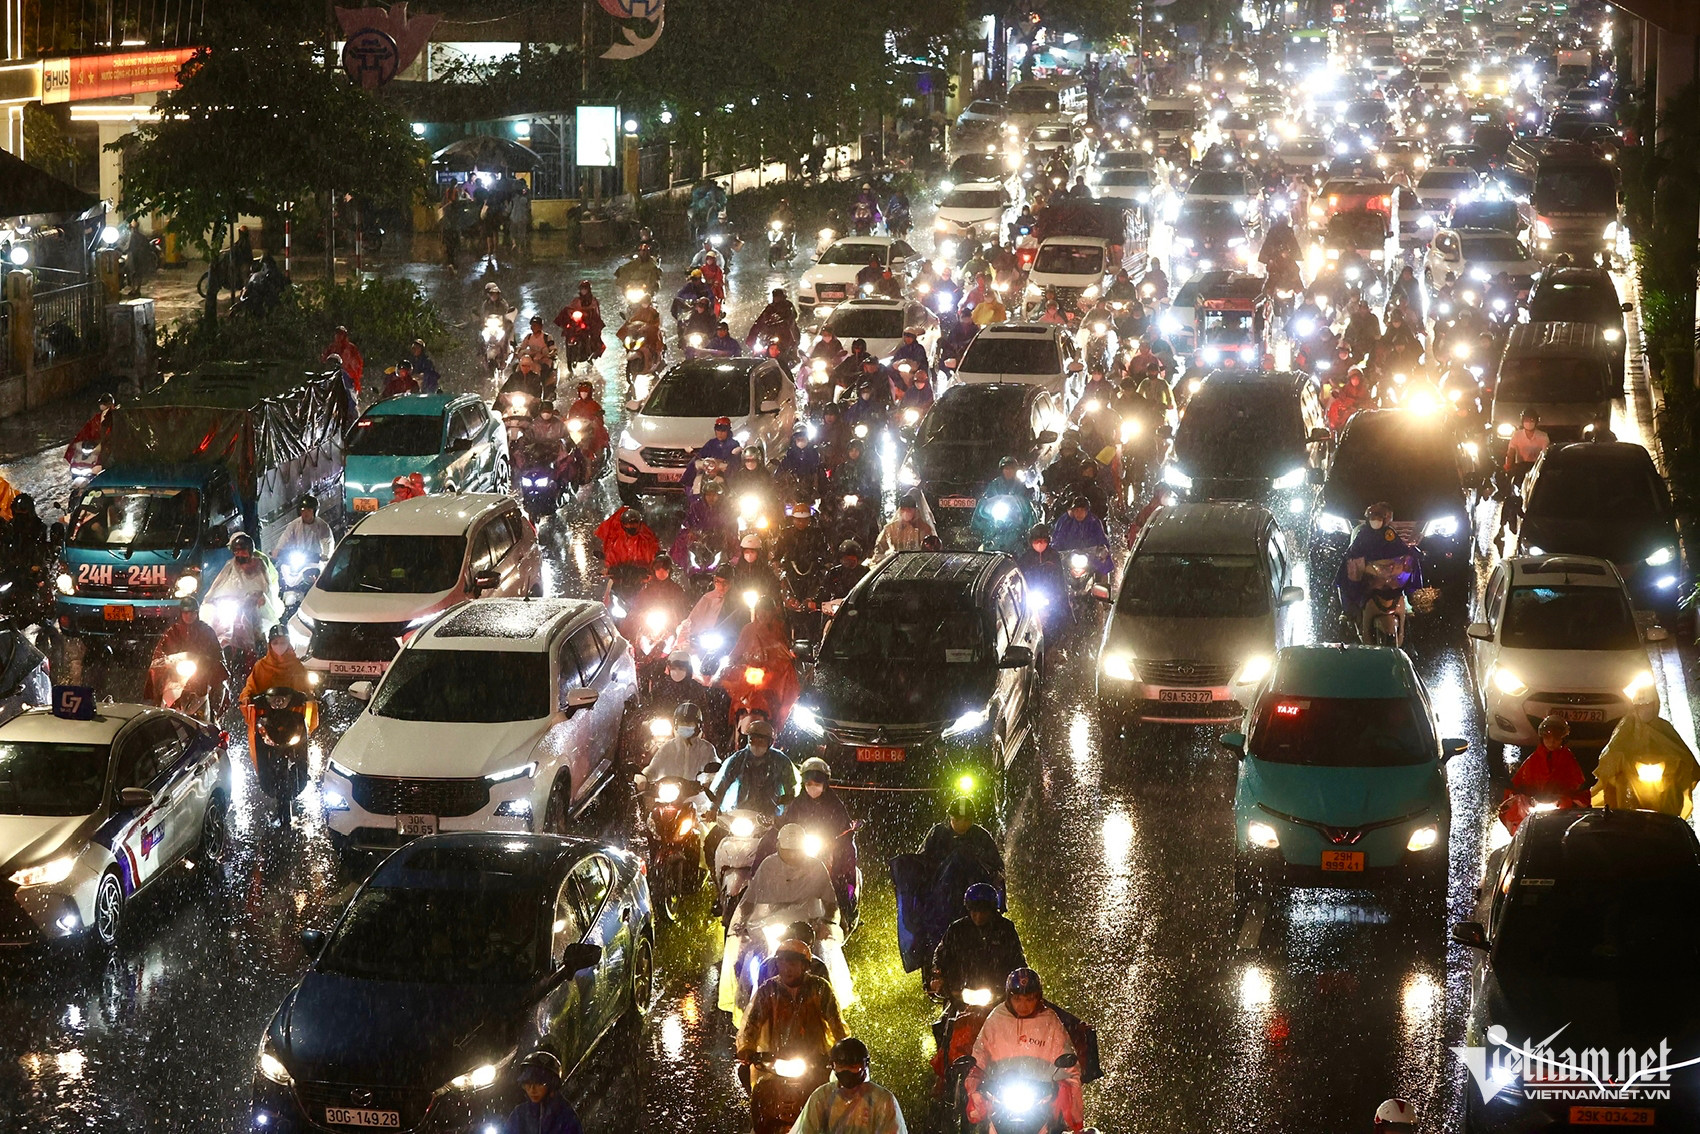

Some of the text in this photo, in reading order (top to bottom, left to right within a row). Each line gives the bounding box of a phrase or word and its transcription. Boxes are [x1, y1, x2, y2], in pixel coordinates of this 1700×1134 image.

[52, 70, 69, 86] HUS
[78, 563, 167, 585] 24H 24H
[61, 691, 82, 713] G7
[1277, 705, 1299, 715] TAXI
[408, 816, 425, 824] 30K
[1333, 852, 1353, 861] 29H
[327, 1109, 399, 1126] 30G-149.28
[1577, 1110, 1648, 1123] 29K-034.28
